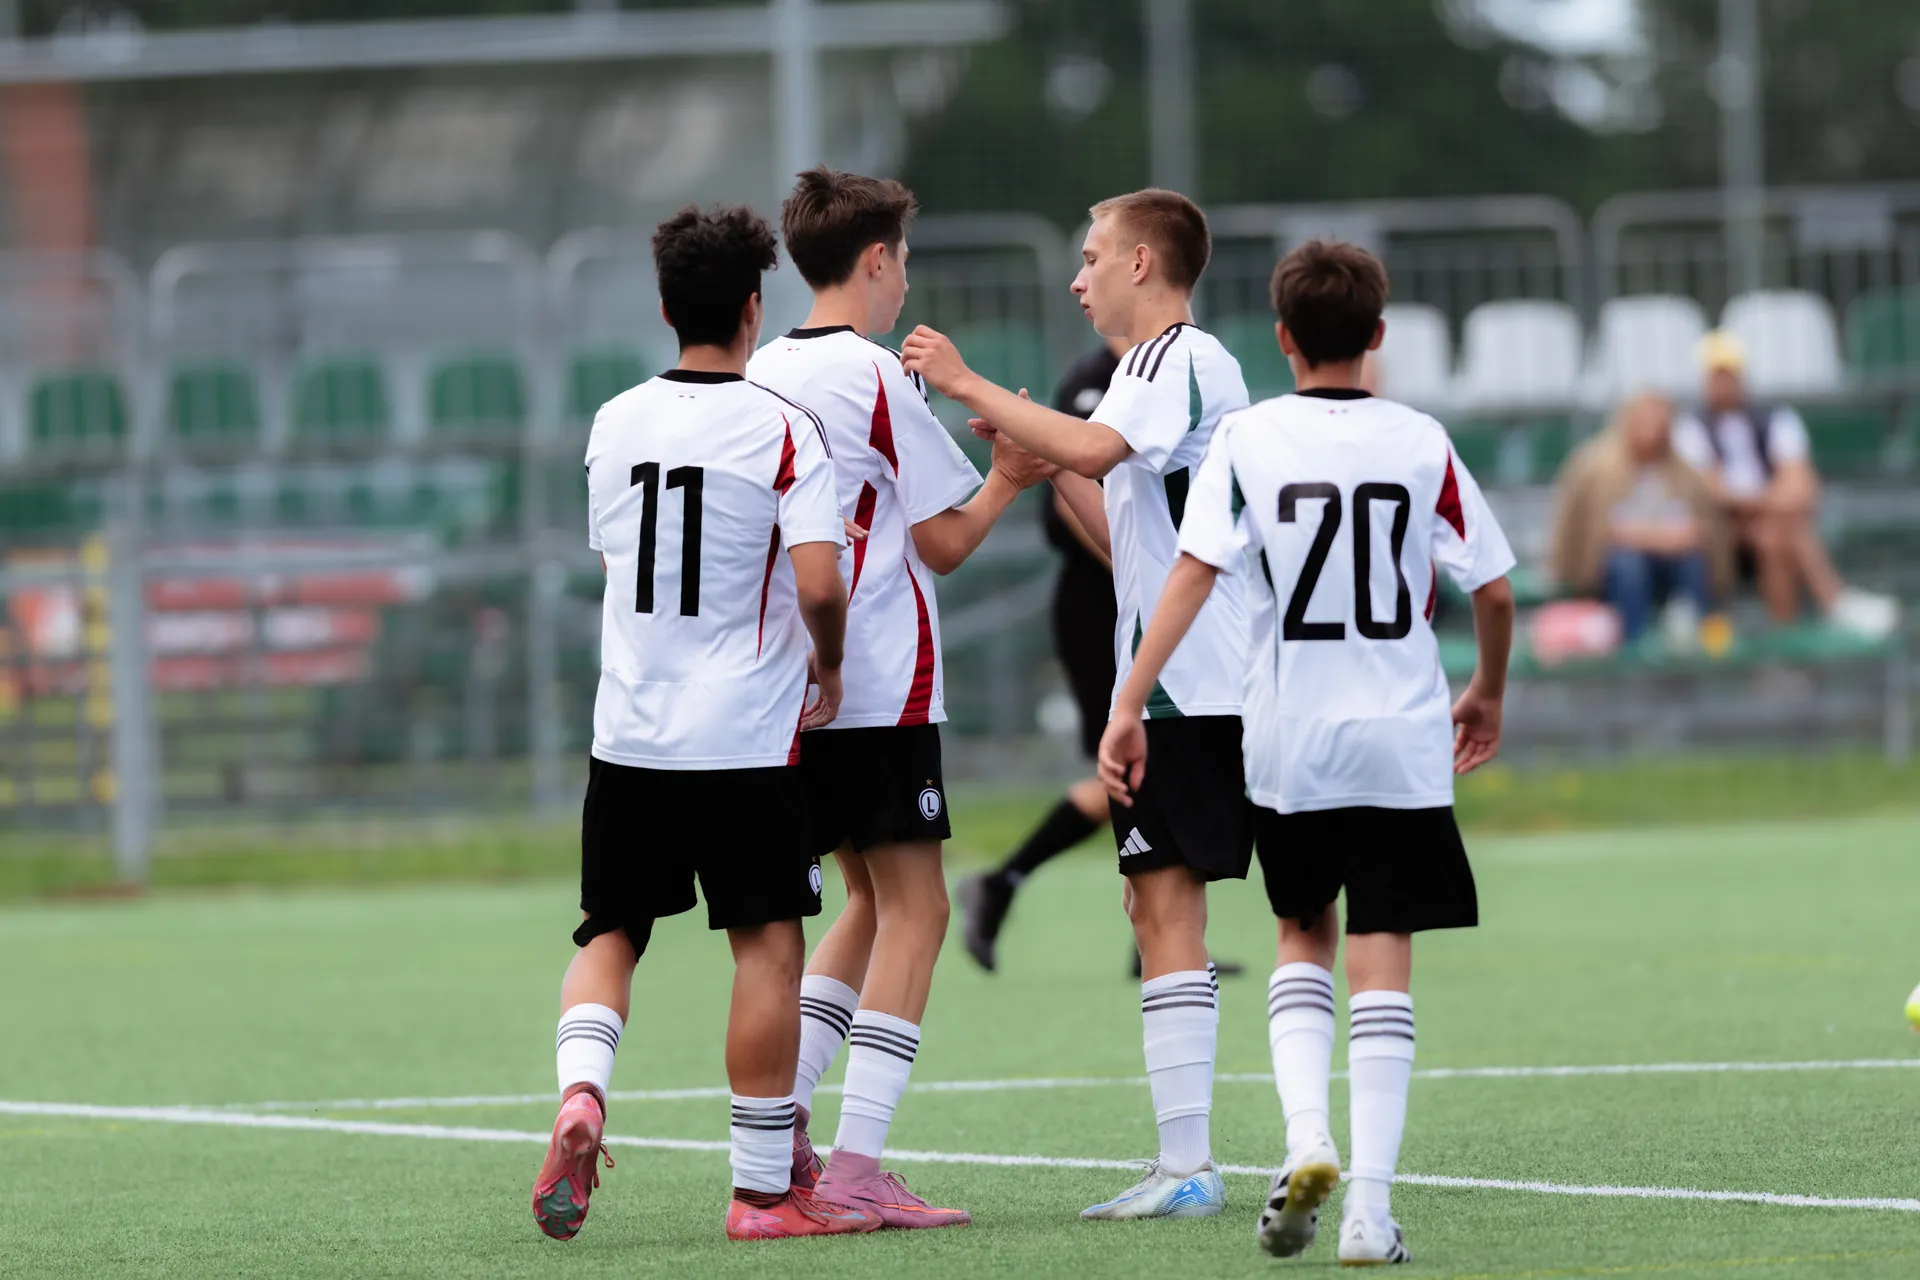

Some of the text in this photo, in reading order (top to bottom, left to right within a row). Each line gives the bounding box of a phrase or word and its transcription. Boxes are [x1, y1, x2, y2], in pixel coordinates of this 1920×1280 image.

[631, 461, 704, 617] 11
[1278, 482, 1412, 641] 20
[927, 796, 935, 813] L
